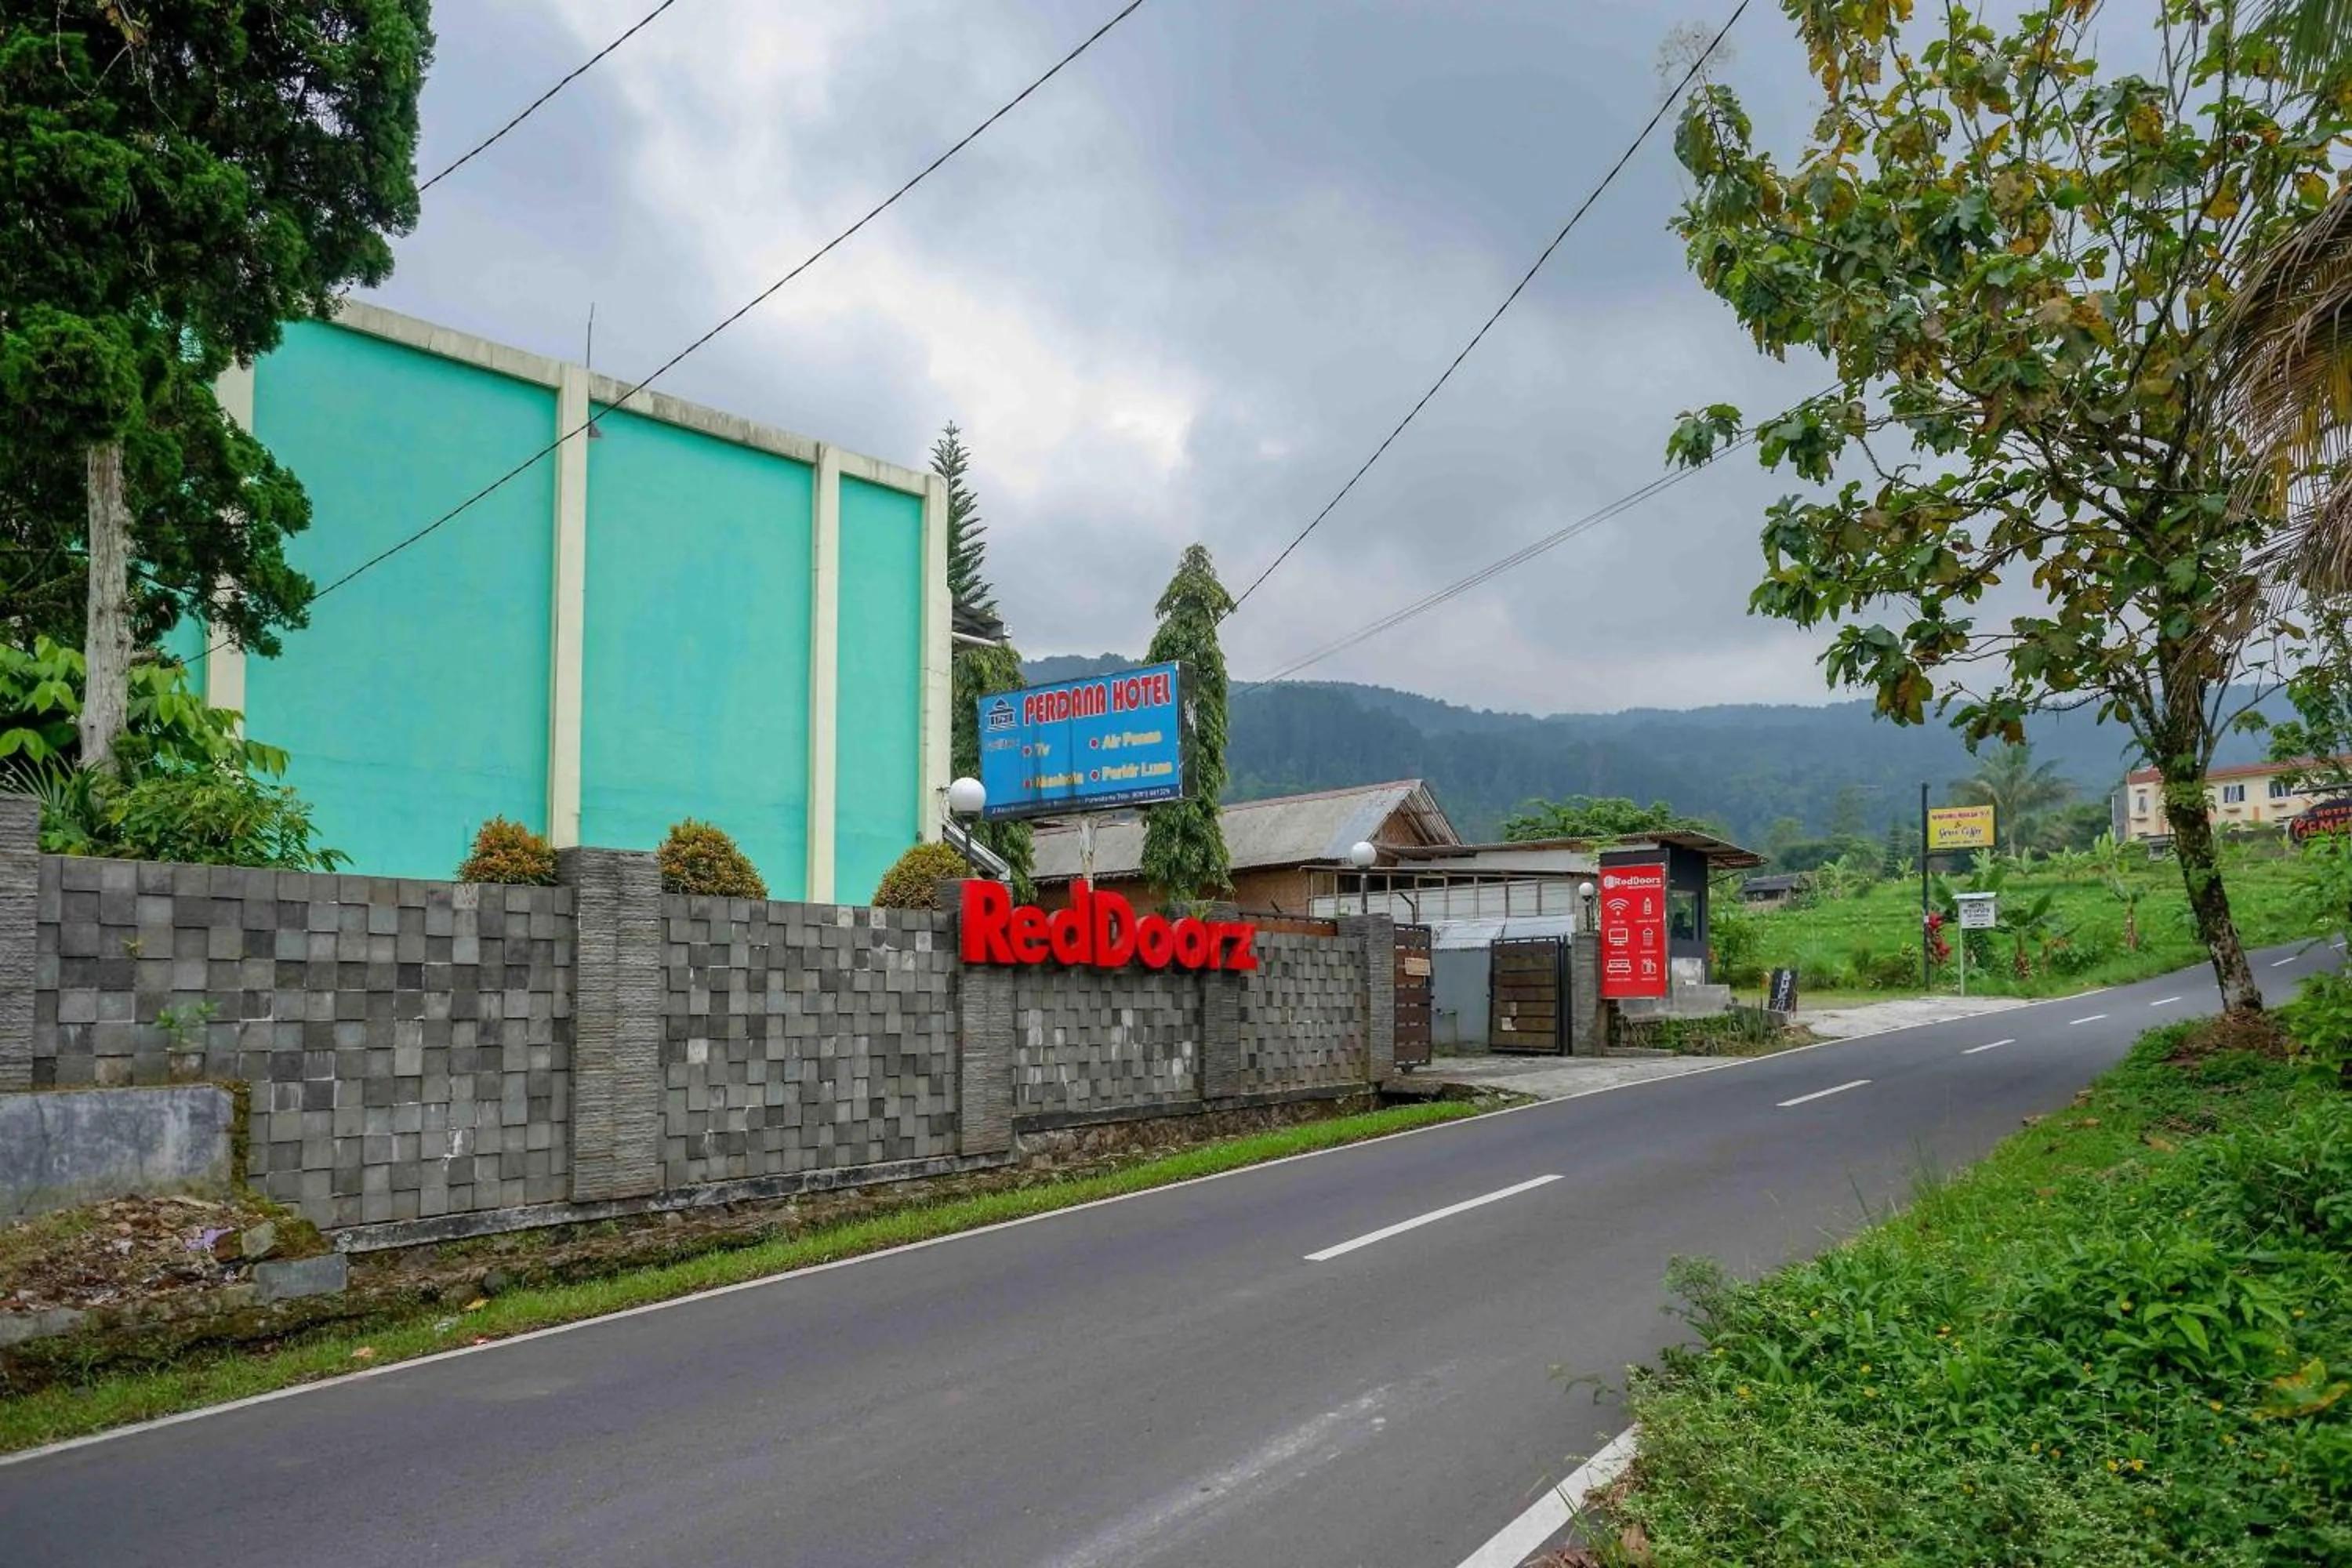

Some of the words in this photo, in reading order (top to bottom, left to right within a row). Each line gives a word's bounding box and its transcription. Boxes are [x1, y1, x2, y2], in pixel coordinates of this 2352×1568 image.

[1024, 683, 1107, 727] PERDANA
[1112, 671, 1171, 713] HOTEL
[961, 878, 1258, 970] RedDoorz
